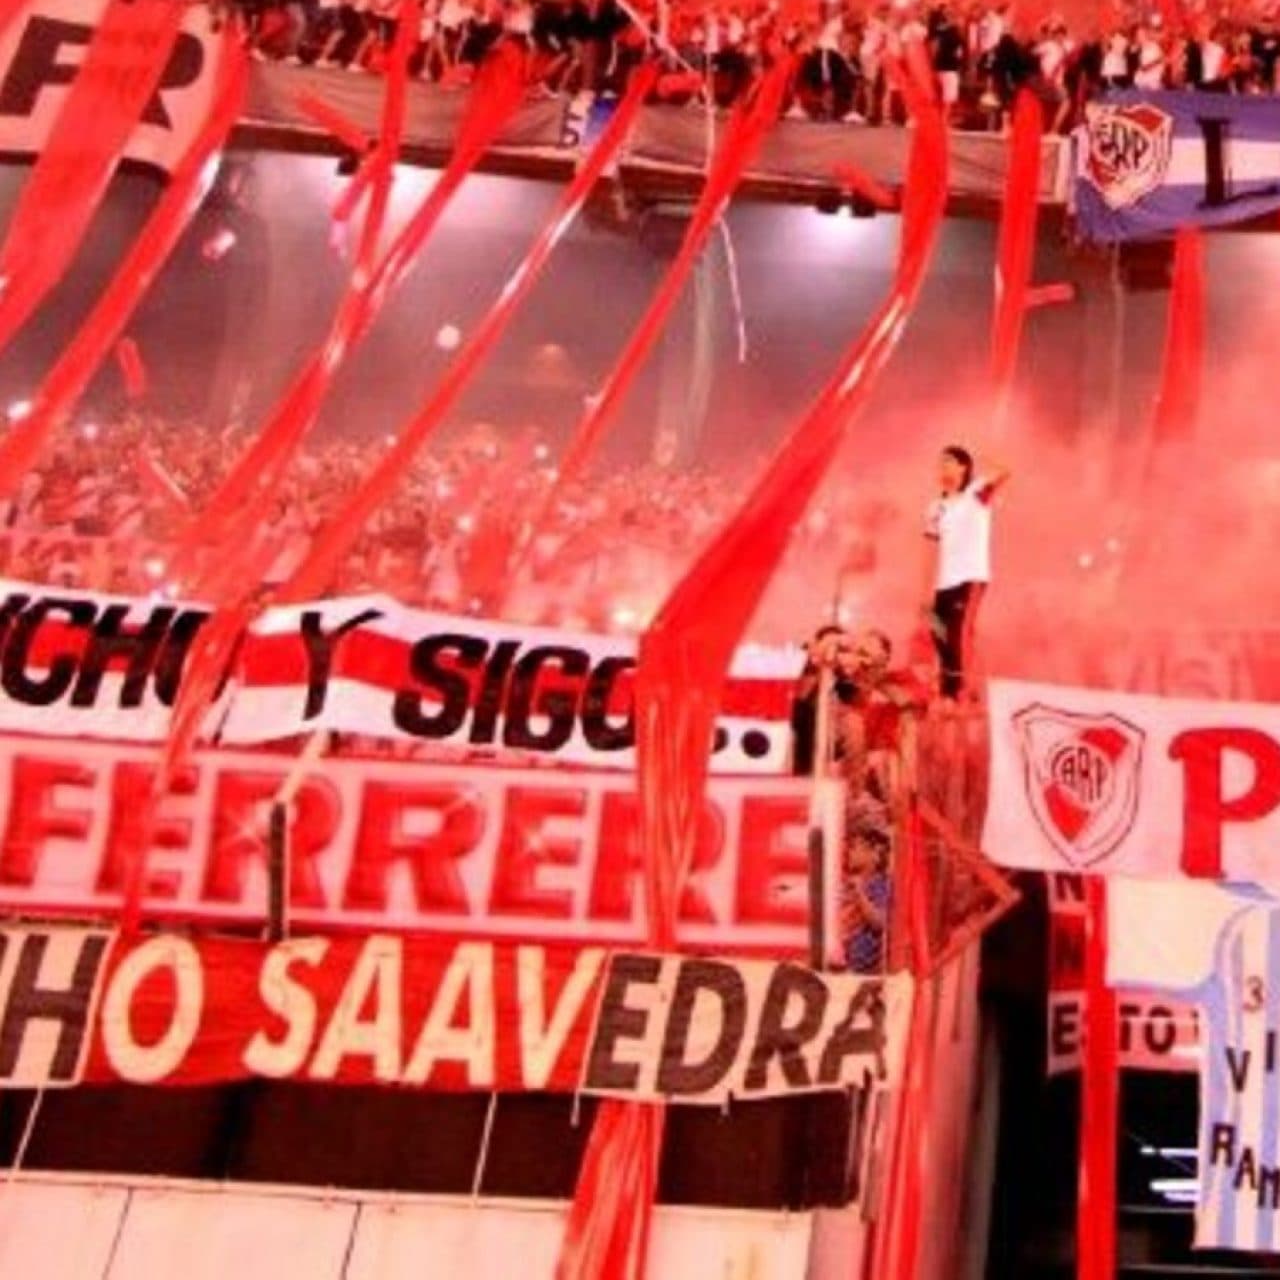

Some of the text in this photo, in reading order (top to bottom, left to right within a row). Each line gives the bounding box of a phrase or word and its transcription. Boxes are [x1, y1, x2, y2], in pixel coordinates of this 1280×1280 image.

[300, 610, 385, 722] Y
[0, 932, 890, 1096] HO SAAVEDRA
[1053, 1002, 1176, 1057] ETO
[1242, 975, 1265, 1013] 3
